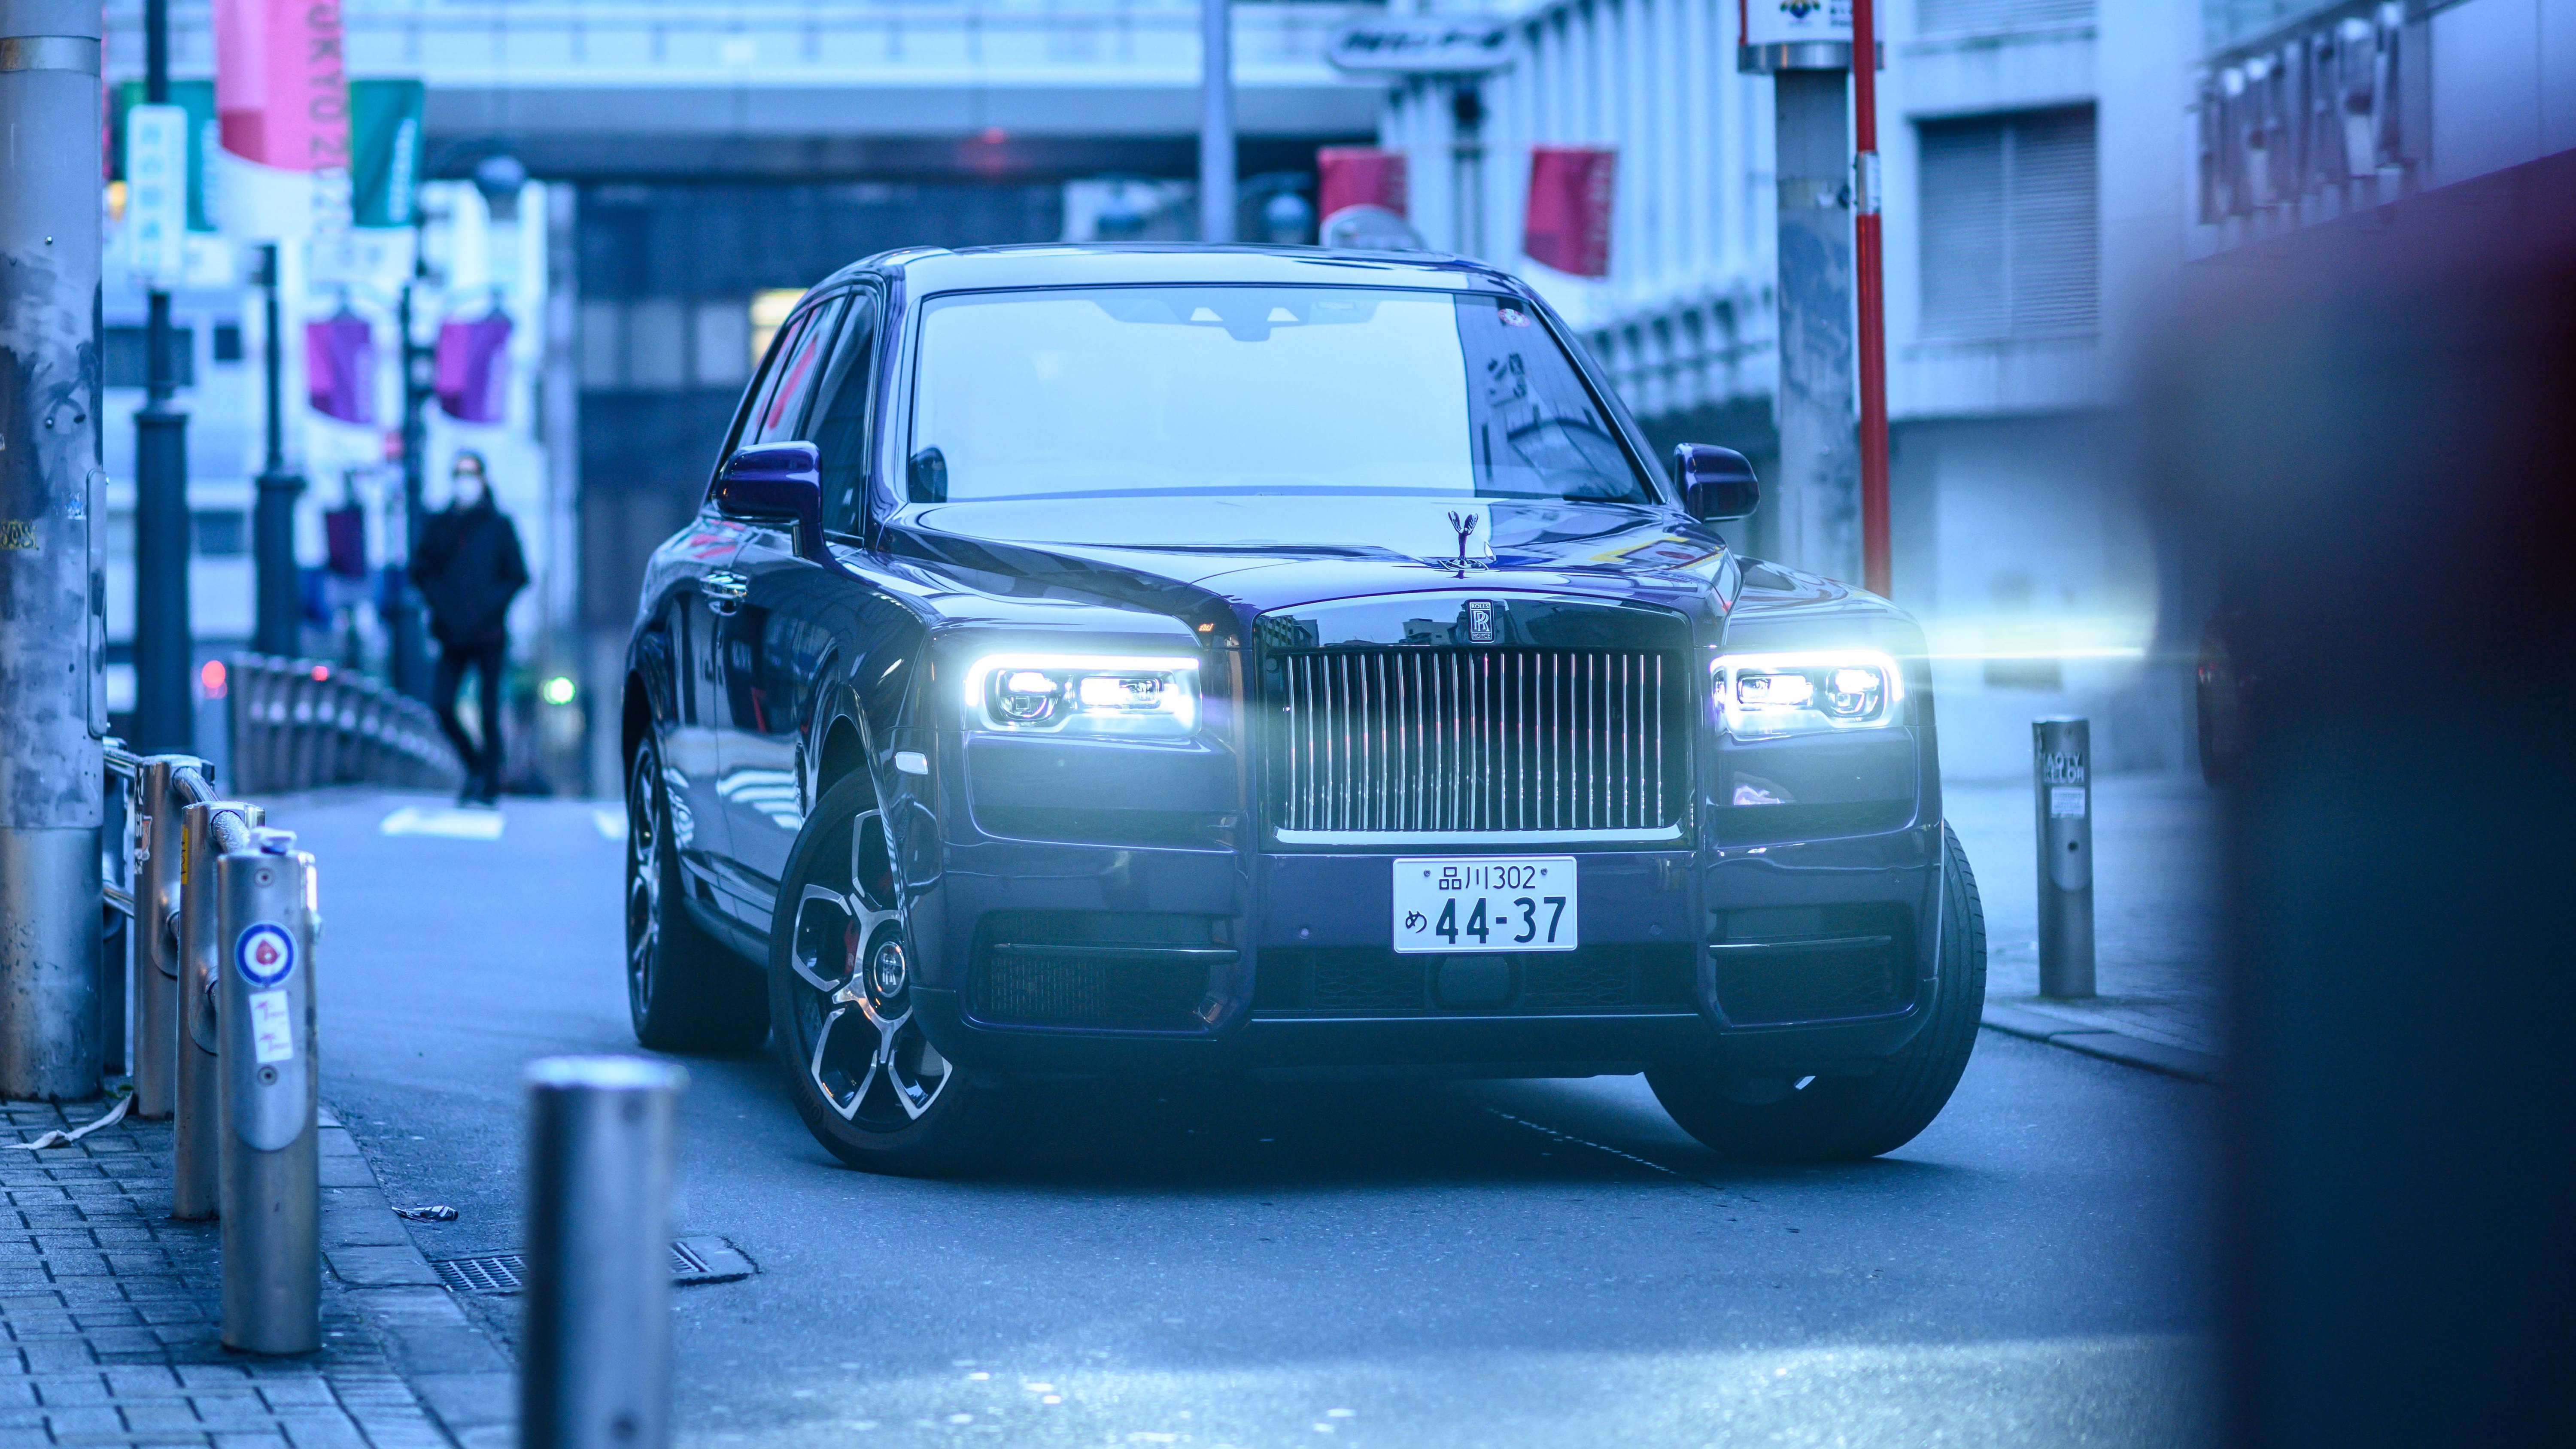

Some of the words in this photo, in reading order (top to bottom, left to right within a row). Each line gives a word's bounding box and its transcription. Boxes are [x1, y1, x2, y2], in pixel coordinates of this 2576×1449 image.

[1473, 611, 1490, 632] RR
[1405, 910, 1427, 933] め
[1436, 896, 1567, 944] 44-37
